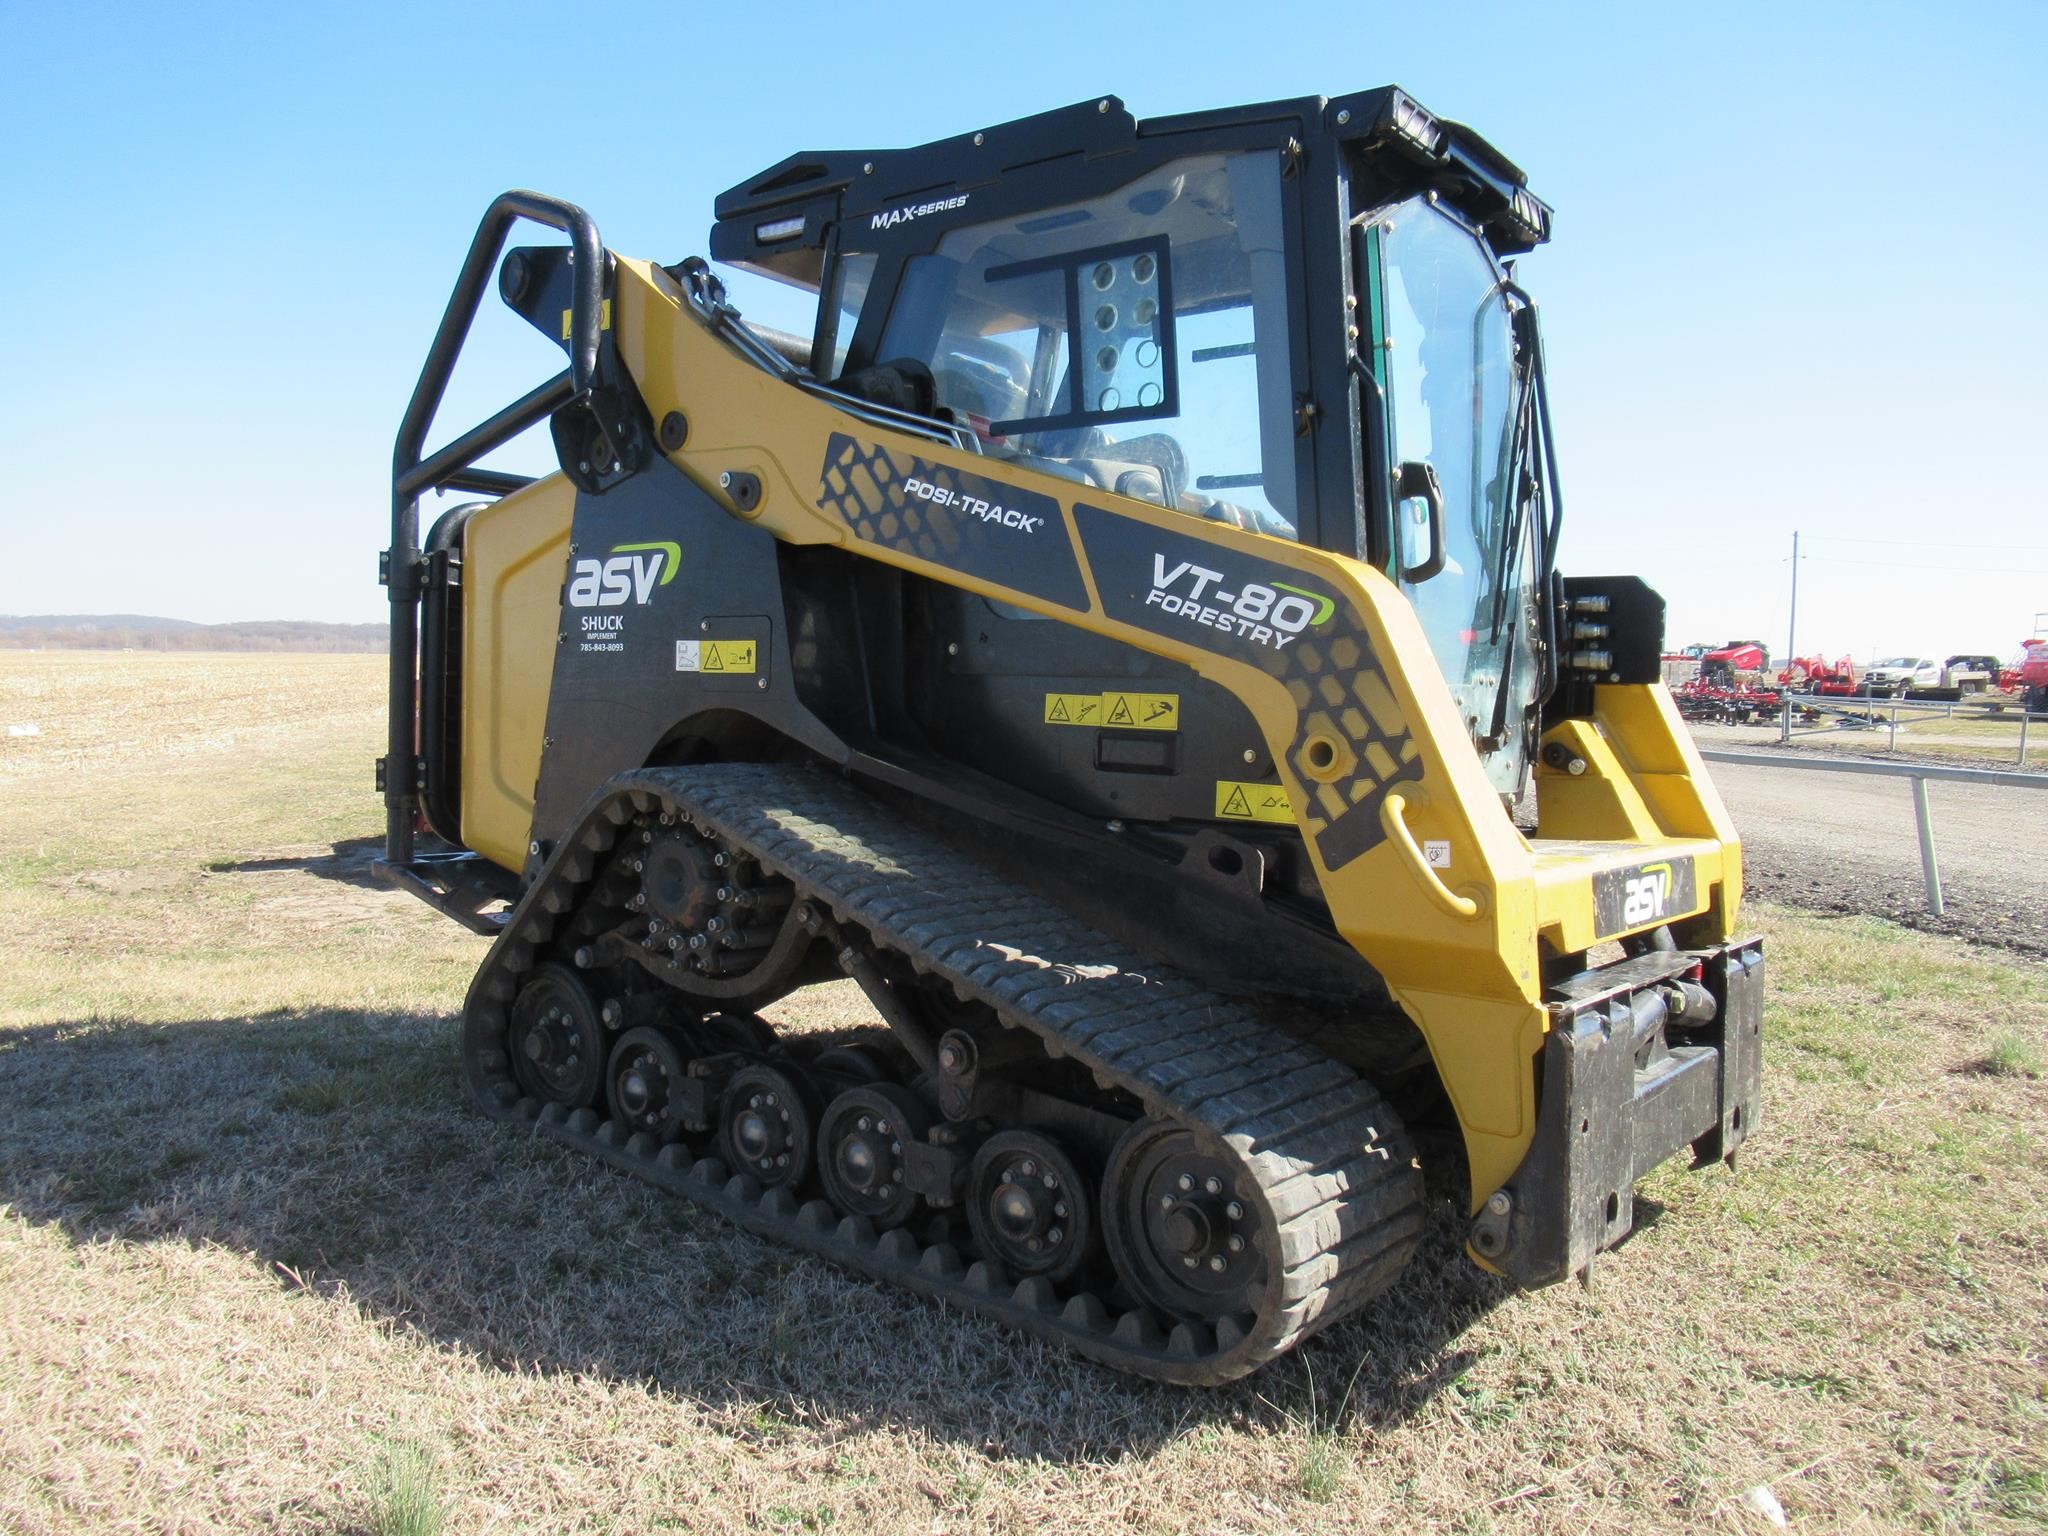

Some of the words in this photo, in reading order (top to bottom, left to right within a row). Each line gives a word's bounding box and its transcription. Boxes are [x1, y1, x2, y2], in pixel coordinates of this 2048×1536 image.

[871, 195, 967, 230] MAX-SERIES
[1152, 553, 1315, 633] VT-80
[581, 615, 624, 631] SHUCK
[1145, 588, 1295, 650] FORESTRY
[580, 643, 624, 652] 785-843-8093
[587, 632, 617, 640] IMPLEMENT
